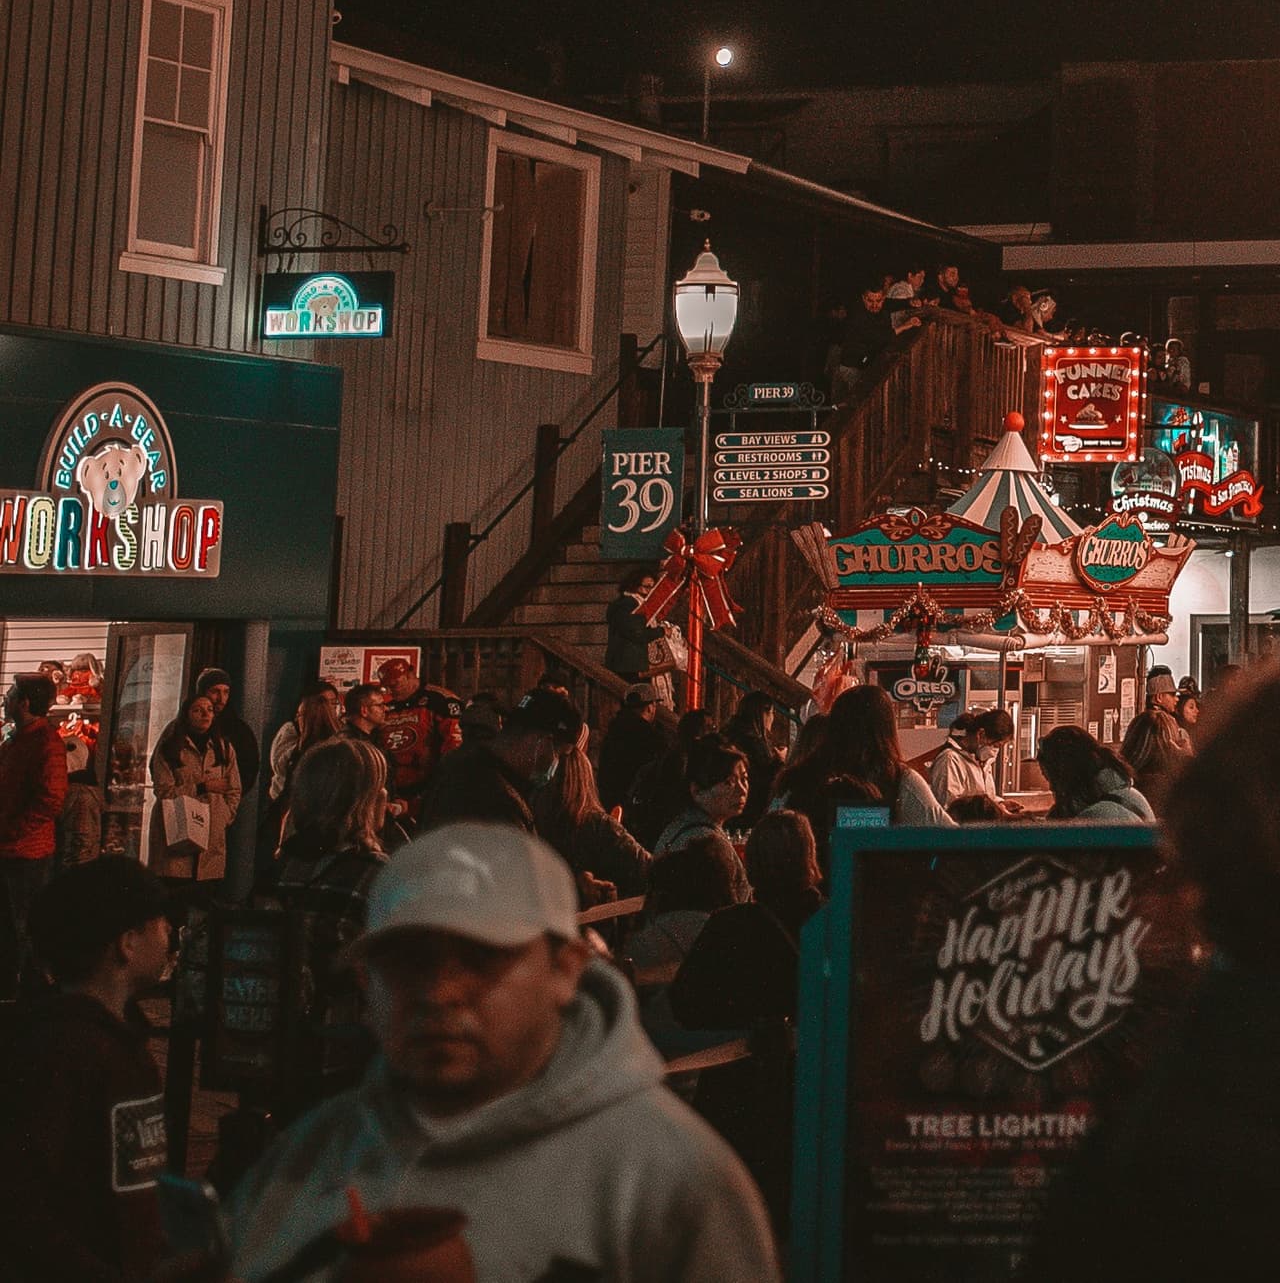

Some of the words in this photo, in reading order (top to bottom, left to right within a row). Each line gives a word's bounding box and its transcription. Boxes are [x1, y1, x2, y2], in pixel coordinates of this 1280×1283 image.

[269, 311, 377, 332] WORKSHOP
[1054, 362, 1132, 385] FUNNEL
[753, 387, 781, 399] PIER
[781, 385, 794, 398] 39
[1067, 382, 1123, 401] CAKES
[741, 436, 763, 445] BAY
[764, 435, 798, 445] VIEWS
[611, 451, 673, 476] PIER
[737, 452, 803, 463] RESTROOMS
[730, 471, 763, 481] LEVEL
[764, 470, 771, 480] 2
[773, 469, 808, 480] SHOPS
[739, 488, 759, 499] SEA
[762, 488, 794, 498] LIONS
[1112, 492, 1174, 513] Christmas
[608, 477, 674, 533] 39
[0, 495, 221, 572] WORKSHOP
[829, 540, 1003, 576] CHURROS
[1080, 535, 1149, 569] CHURROS
[897, 679, 951, 696] OREO
[920, 917, 1152, 1043] Holidays
[905, 1113, 974, 1138] TREE
[978, 1112, 1088, 1138] LIGHTIN
